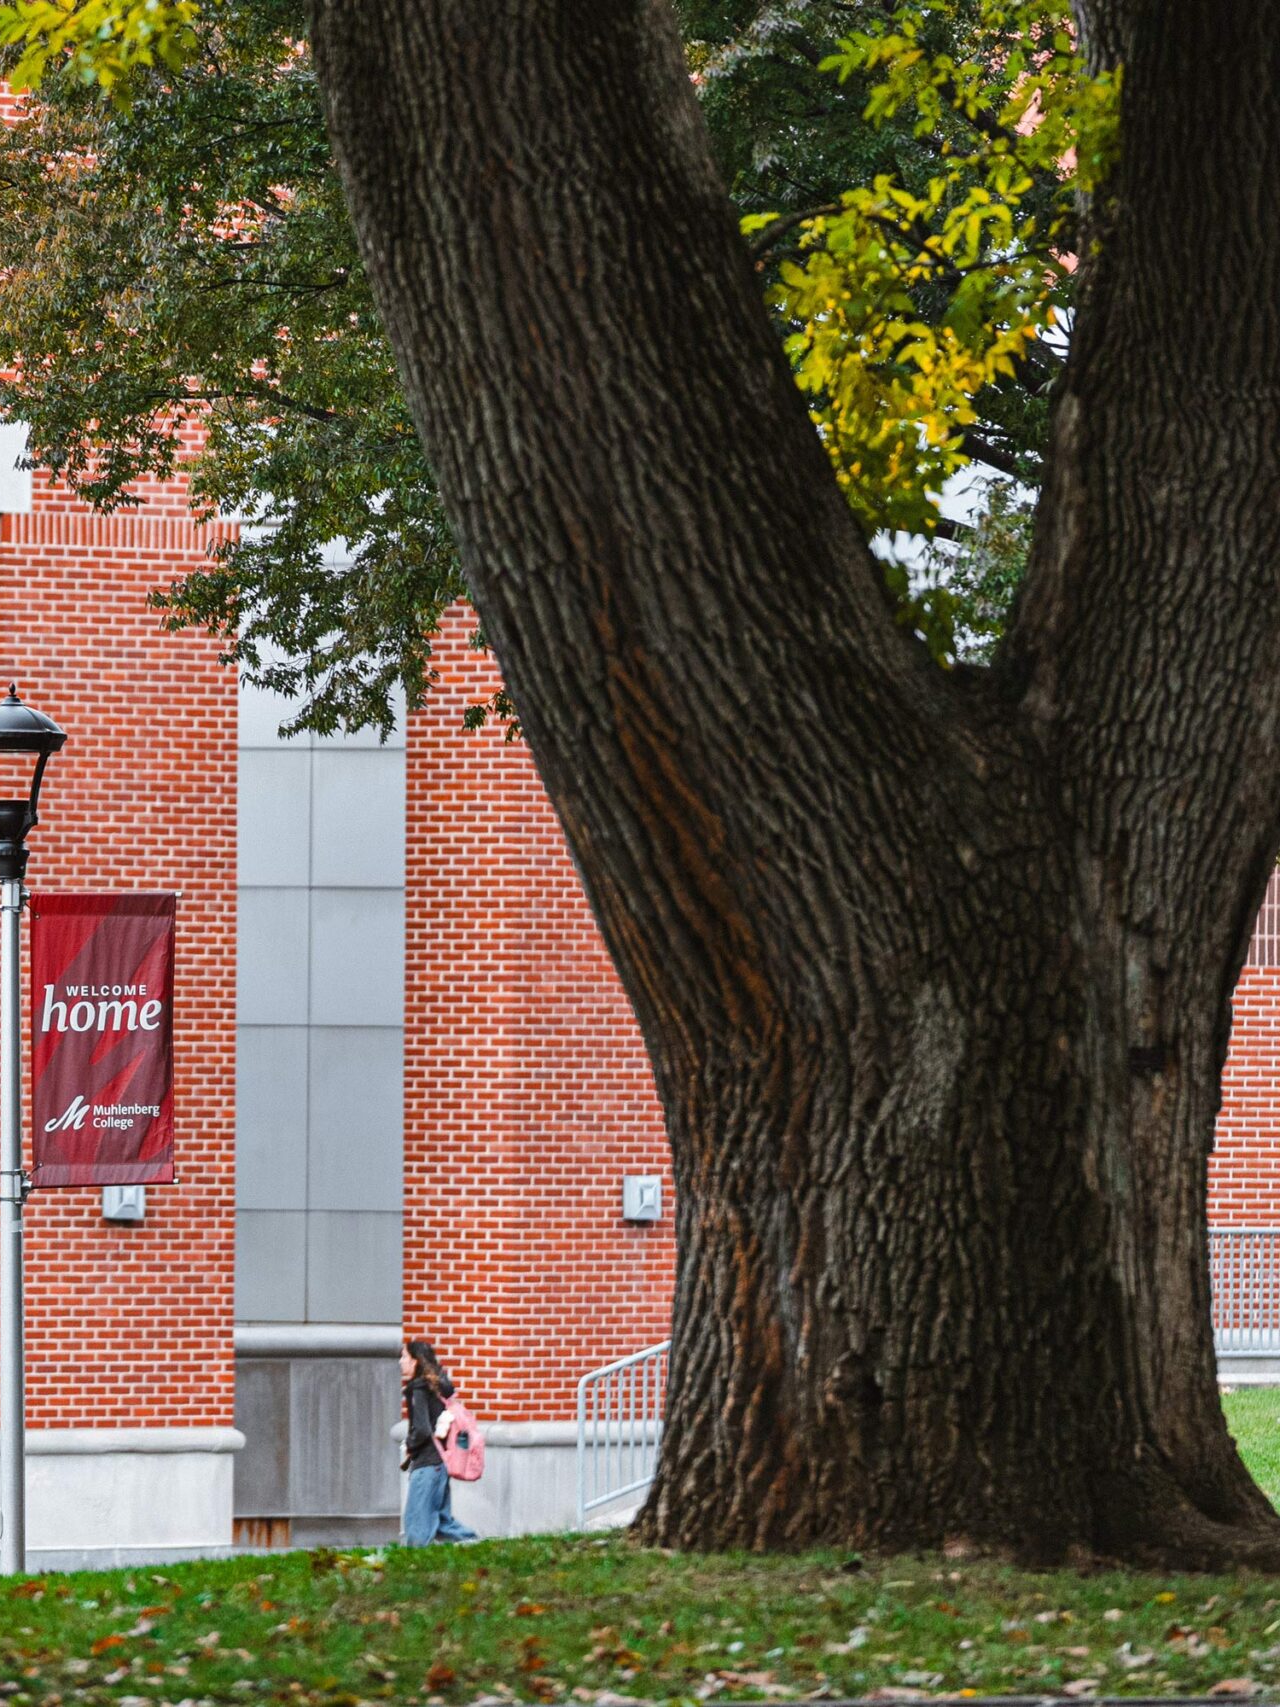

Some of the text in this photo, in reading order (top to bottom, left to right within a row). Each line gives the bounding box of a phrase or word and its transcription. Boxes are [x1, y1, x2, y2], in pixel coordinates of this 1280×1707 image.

[66, 985, 147, 997] WELCOME
[41, 984, 162, 1032] home
[93, 1103, 160, 1118] Muhlenberg
[93, 1117, 134, 1129] College
